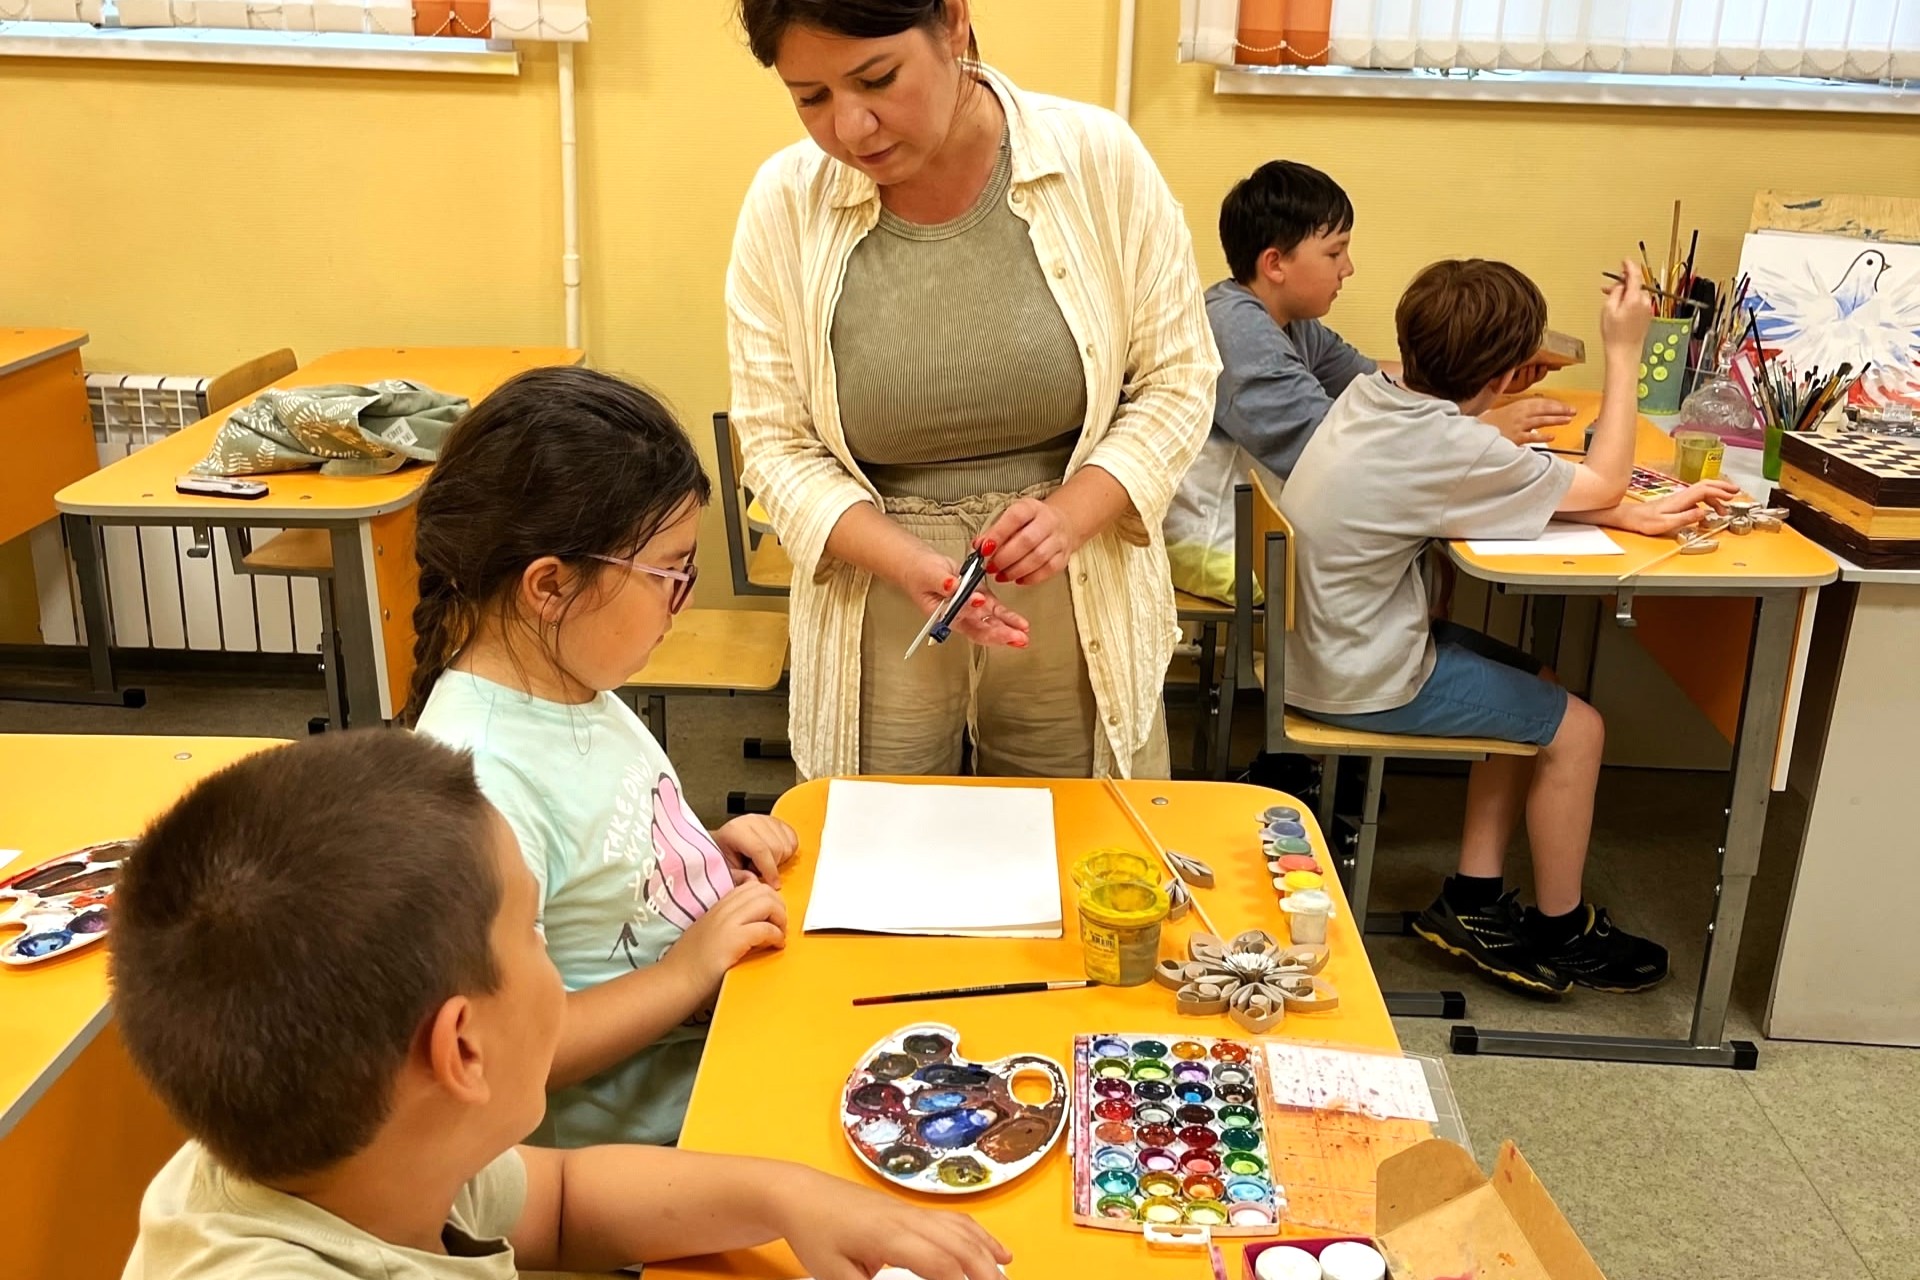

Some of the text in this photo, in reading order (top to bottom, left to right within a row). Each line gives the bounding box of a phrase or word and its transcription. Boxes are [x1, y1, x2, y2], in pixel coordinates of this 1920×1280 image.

[603, 752, 654, 863] TAKE ONLY
[624, 794, 654, 863] WHAT
[628, 841, 666, 902] YOU
[632, 875, 674, 928] NEED
